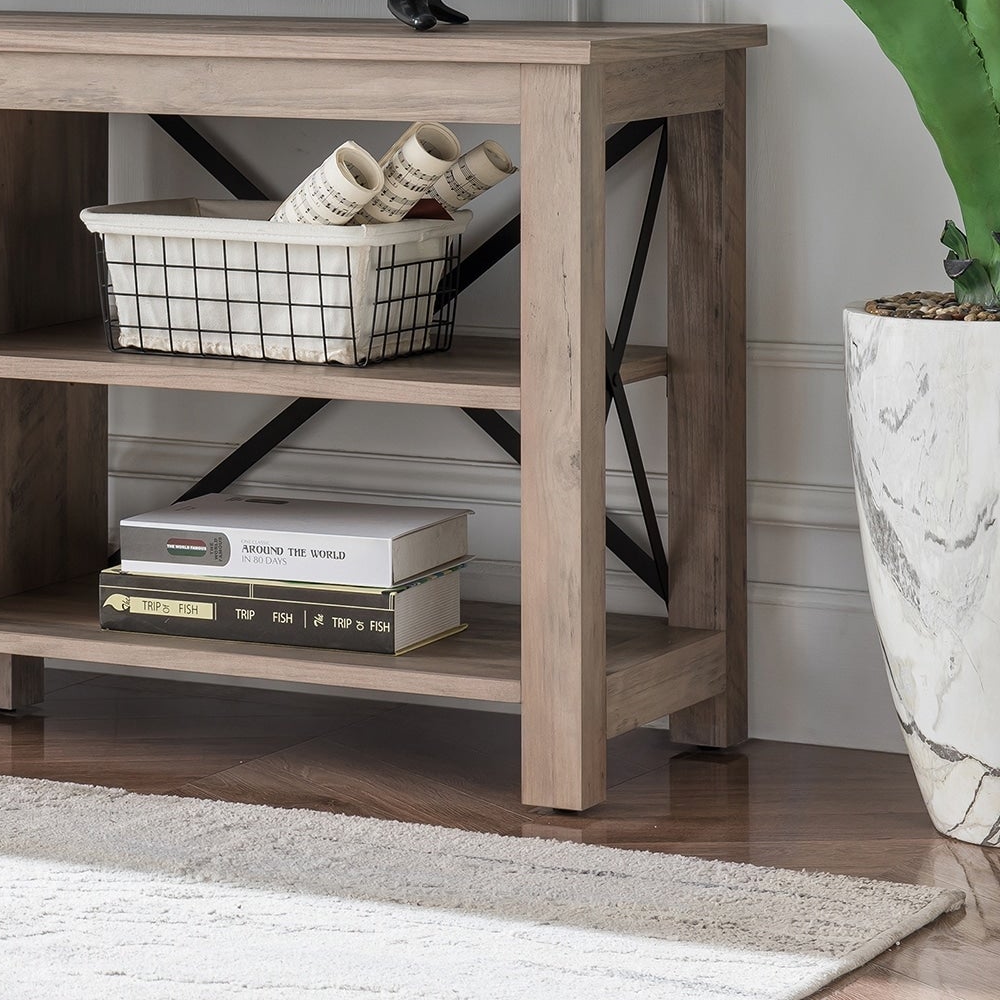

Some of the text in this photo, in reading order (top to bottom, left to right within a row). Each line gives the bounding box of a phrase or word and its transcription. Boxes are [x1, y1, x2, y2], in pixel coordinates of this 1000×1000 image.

[241, 555, 288, 566] IN 80 DAYS
[242, 545, 346, 561] AROUND THE WORLD
[142, 600, 161, 612] TRIP
[178, 603, 199, 615] FISH
[235, 608, 293, 624] TRIP FISH
[332, 616, 353, 629] TRIP
[369, 620, 391, 633] FISH
